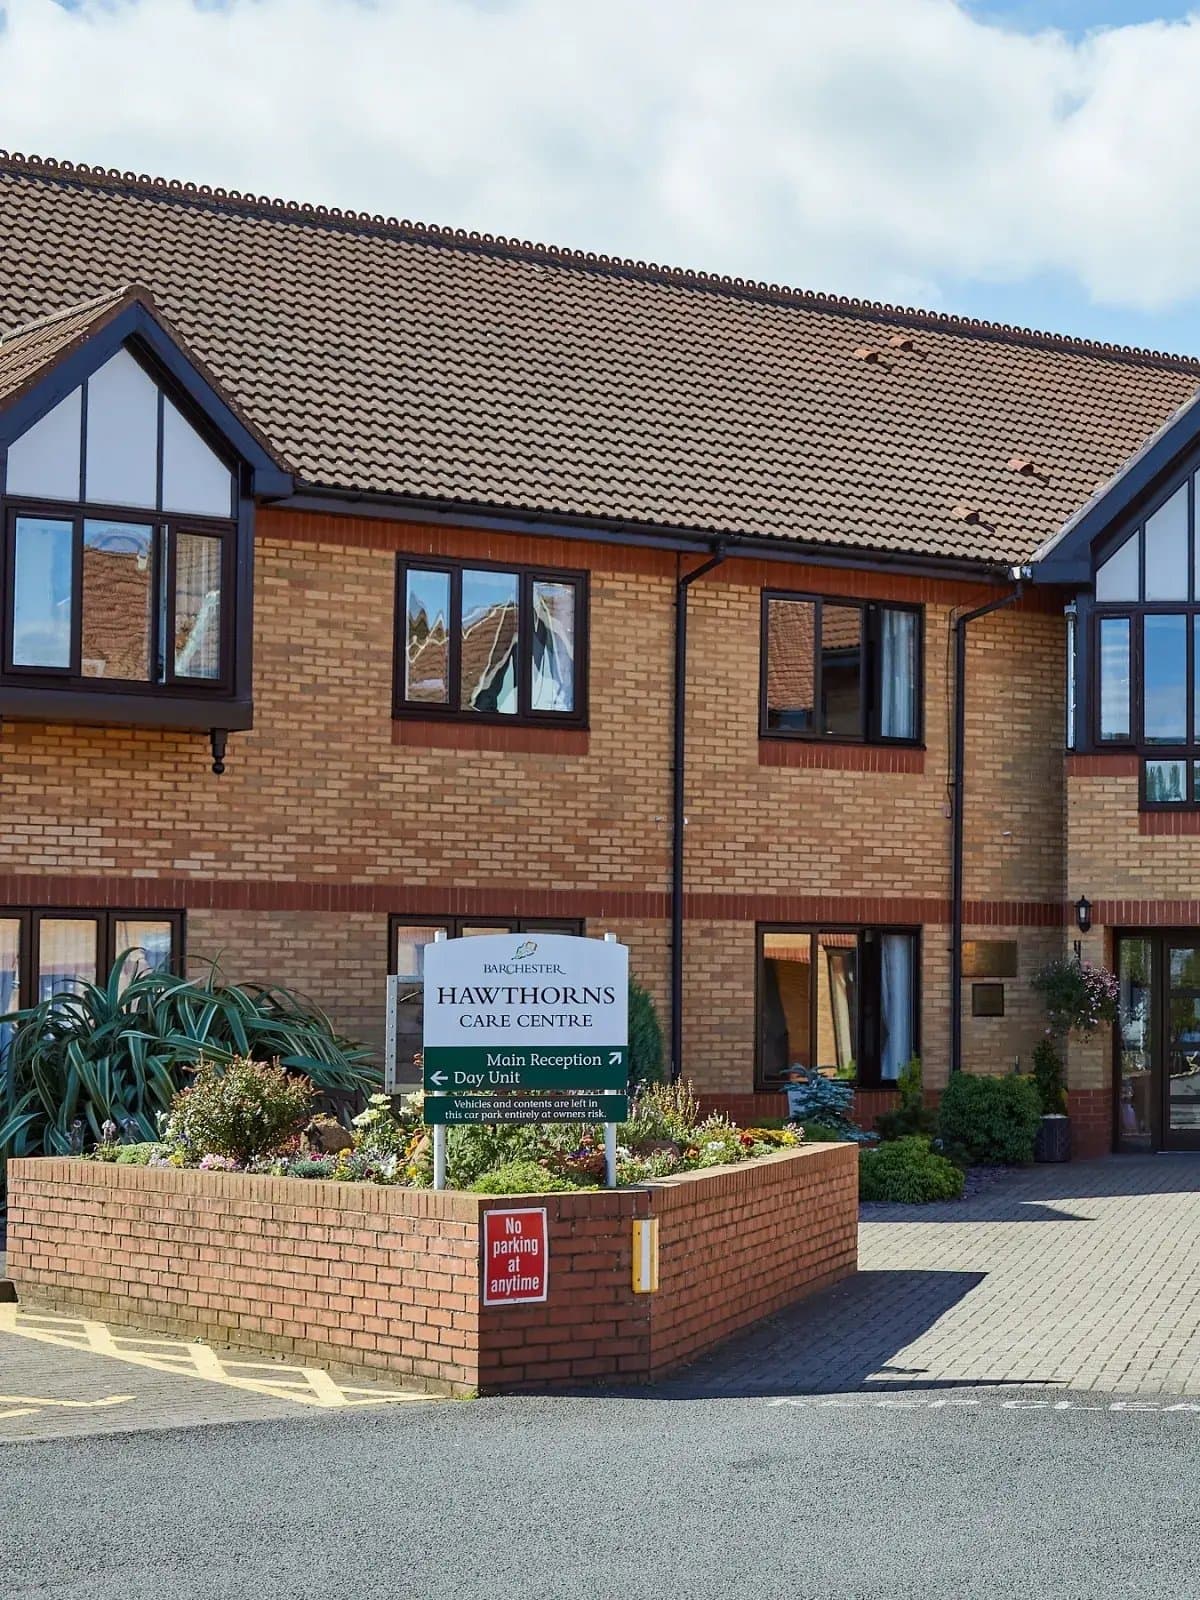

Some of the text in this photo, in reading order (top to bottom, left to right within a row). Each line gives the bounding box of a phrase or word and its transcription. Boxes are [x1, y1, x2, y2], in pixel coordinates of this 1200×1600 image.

[483, 964, 567, 975] BARCHESTER
[437, 986, 615, 1005] HAWTHORNS
[459, 1014, 593, 1028] CARE CENTRE
[487, 1053, 602, 1069] Main Reception
[454, 1071, 520, 1087] Day Unit
[454, 1100, 491, 1108] Vehicles
[493, 1100, 511, 1108] and
[514, 1100, 552, 1108] contents
[571, 1099, 586, 1107] left
[589, 1099, 598, 1107] in
[445, 1110, 462, 1119] this
[481, 1110, 502, 1120] park
[505, 1110, 539, 1121] entirely
[541, 1110, 550, 1118] at
[587, 1109, 606, 1118] risk.
[505, 1217, 521, 1234] No
[493, 1236, 538, 1258] parking
[508, 1256, 520, 1273] at
[491, 1275, 539, 1295] anytime
